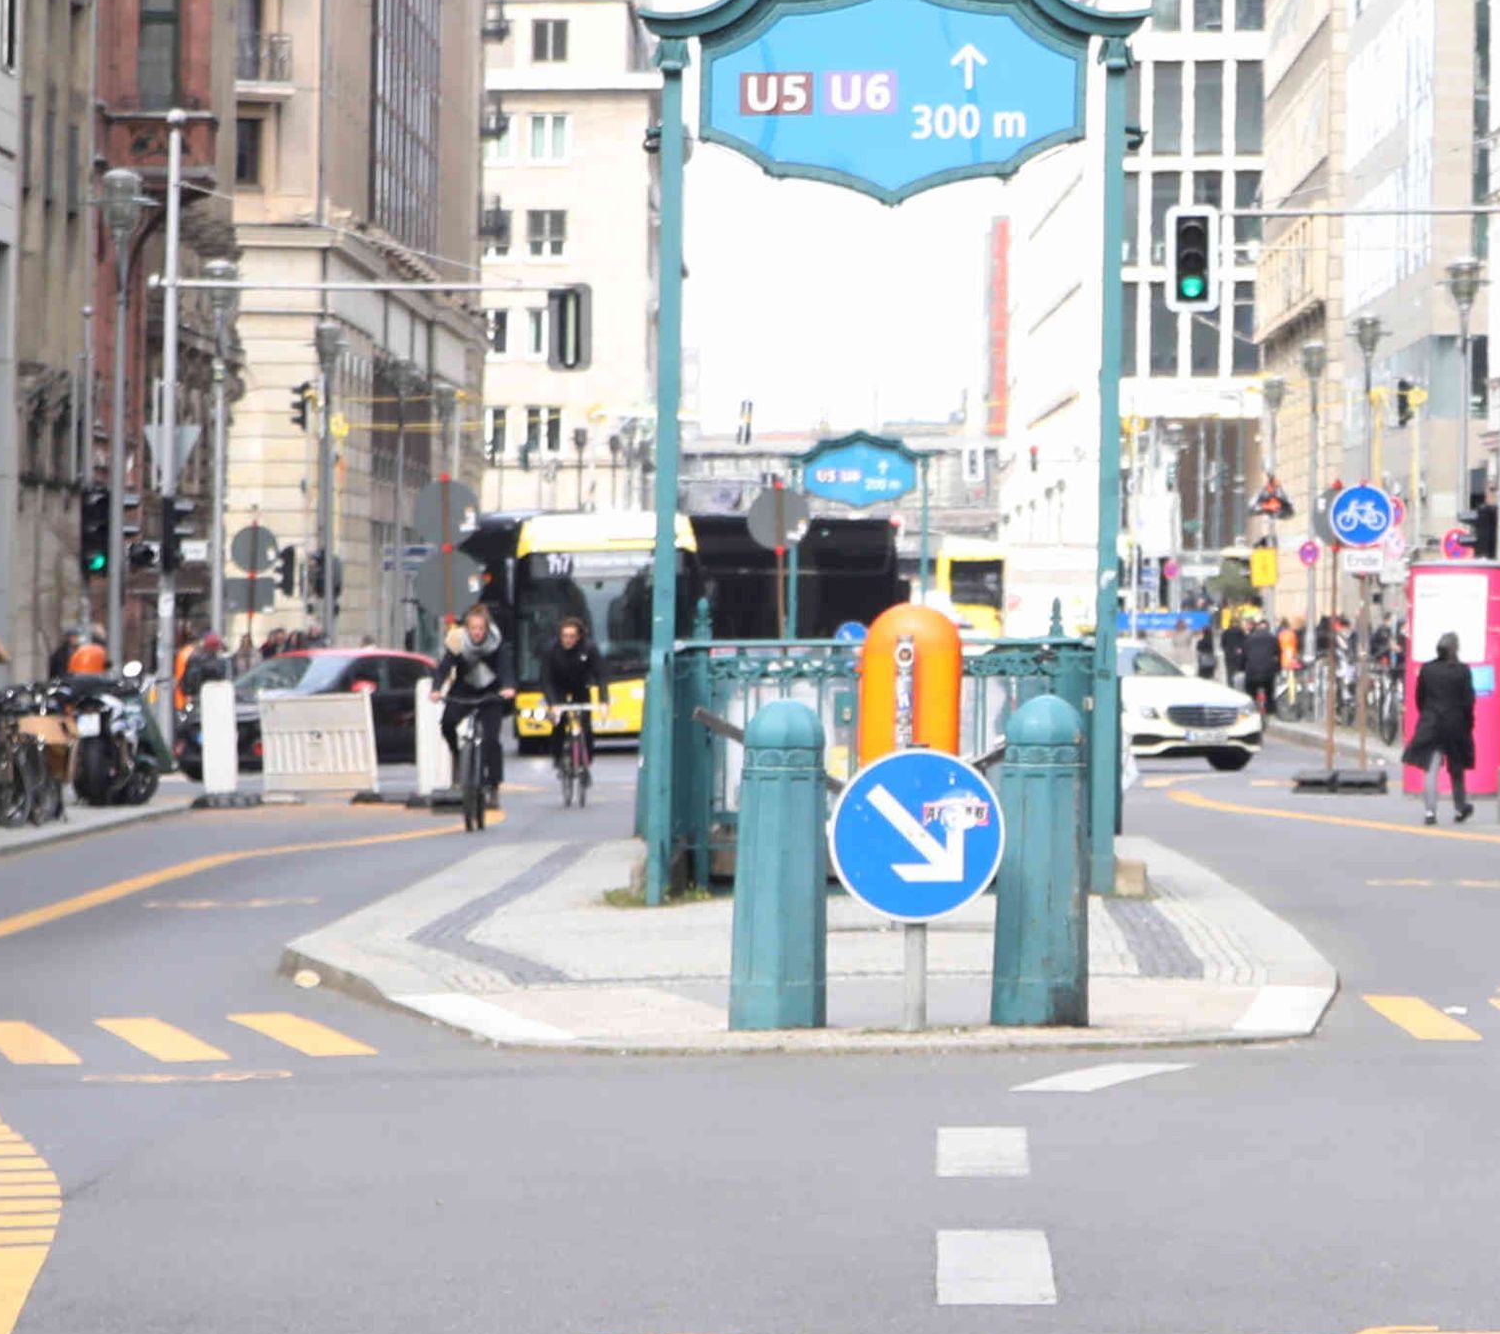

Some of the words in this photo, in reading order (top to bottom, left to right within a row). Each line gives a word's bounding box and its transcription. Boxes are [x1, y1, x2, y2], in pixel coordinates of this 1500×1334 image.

[746, 74, 807, 112] U5
[830, 73, 892, 112] U6
[910, 103, 982, 140] 300
[993, 109, 1027, 139] m
